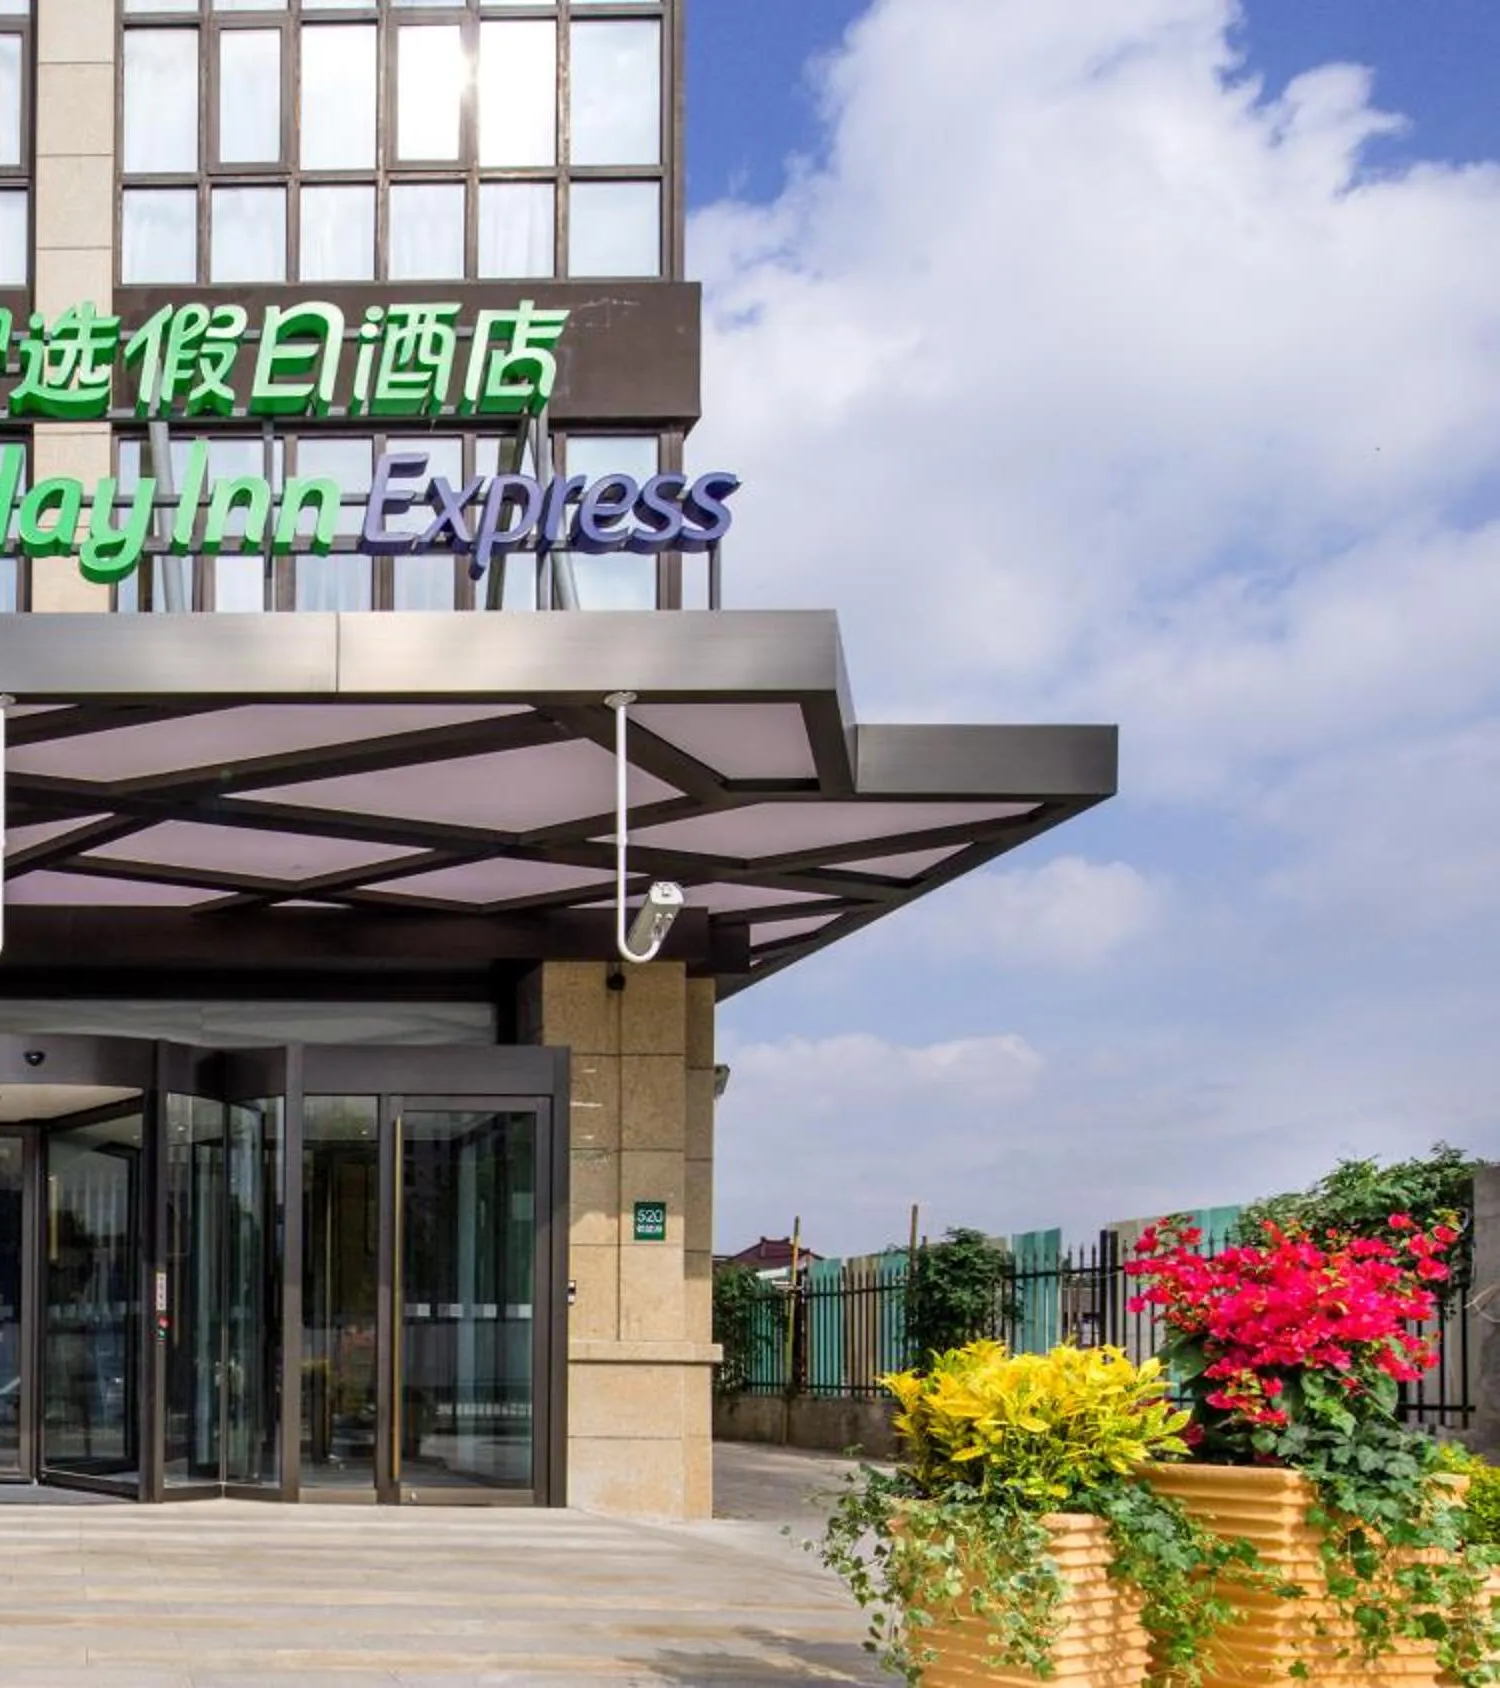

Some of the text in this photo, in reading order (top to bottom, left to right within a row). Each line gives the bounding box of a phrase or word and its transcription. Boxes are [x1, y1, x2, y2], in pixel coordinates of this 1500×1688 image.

[171, 438, 342, 557] Inn
[357, 452, 741, 580] Express
[637, 1209, 663, 1223] 520
